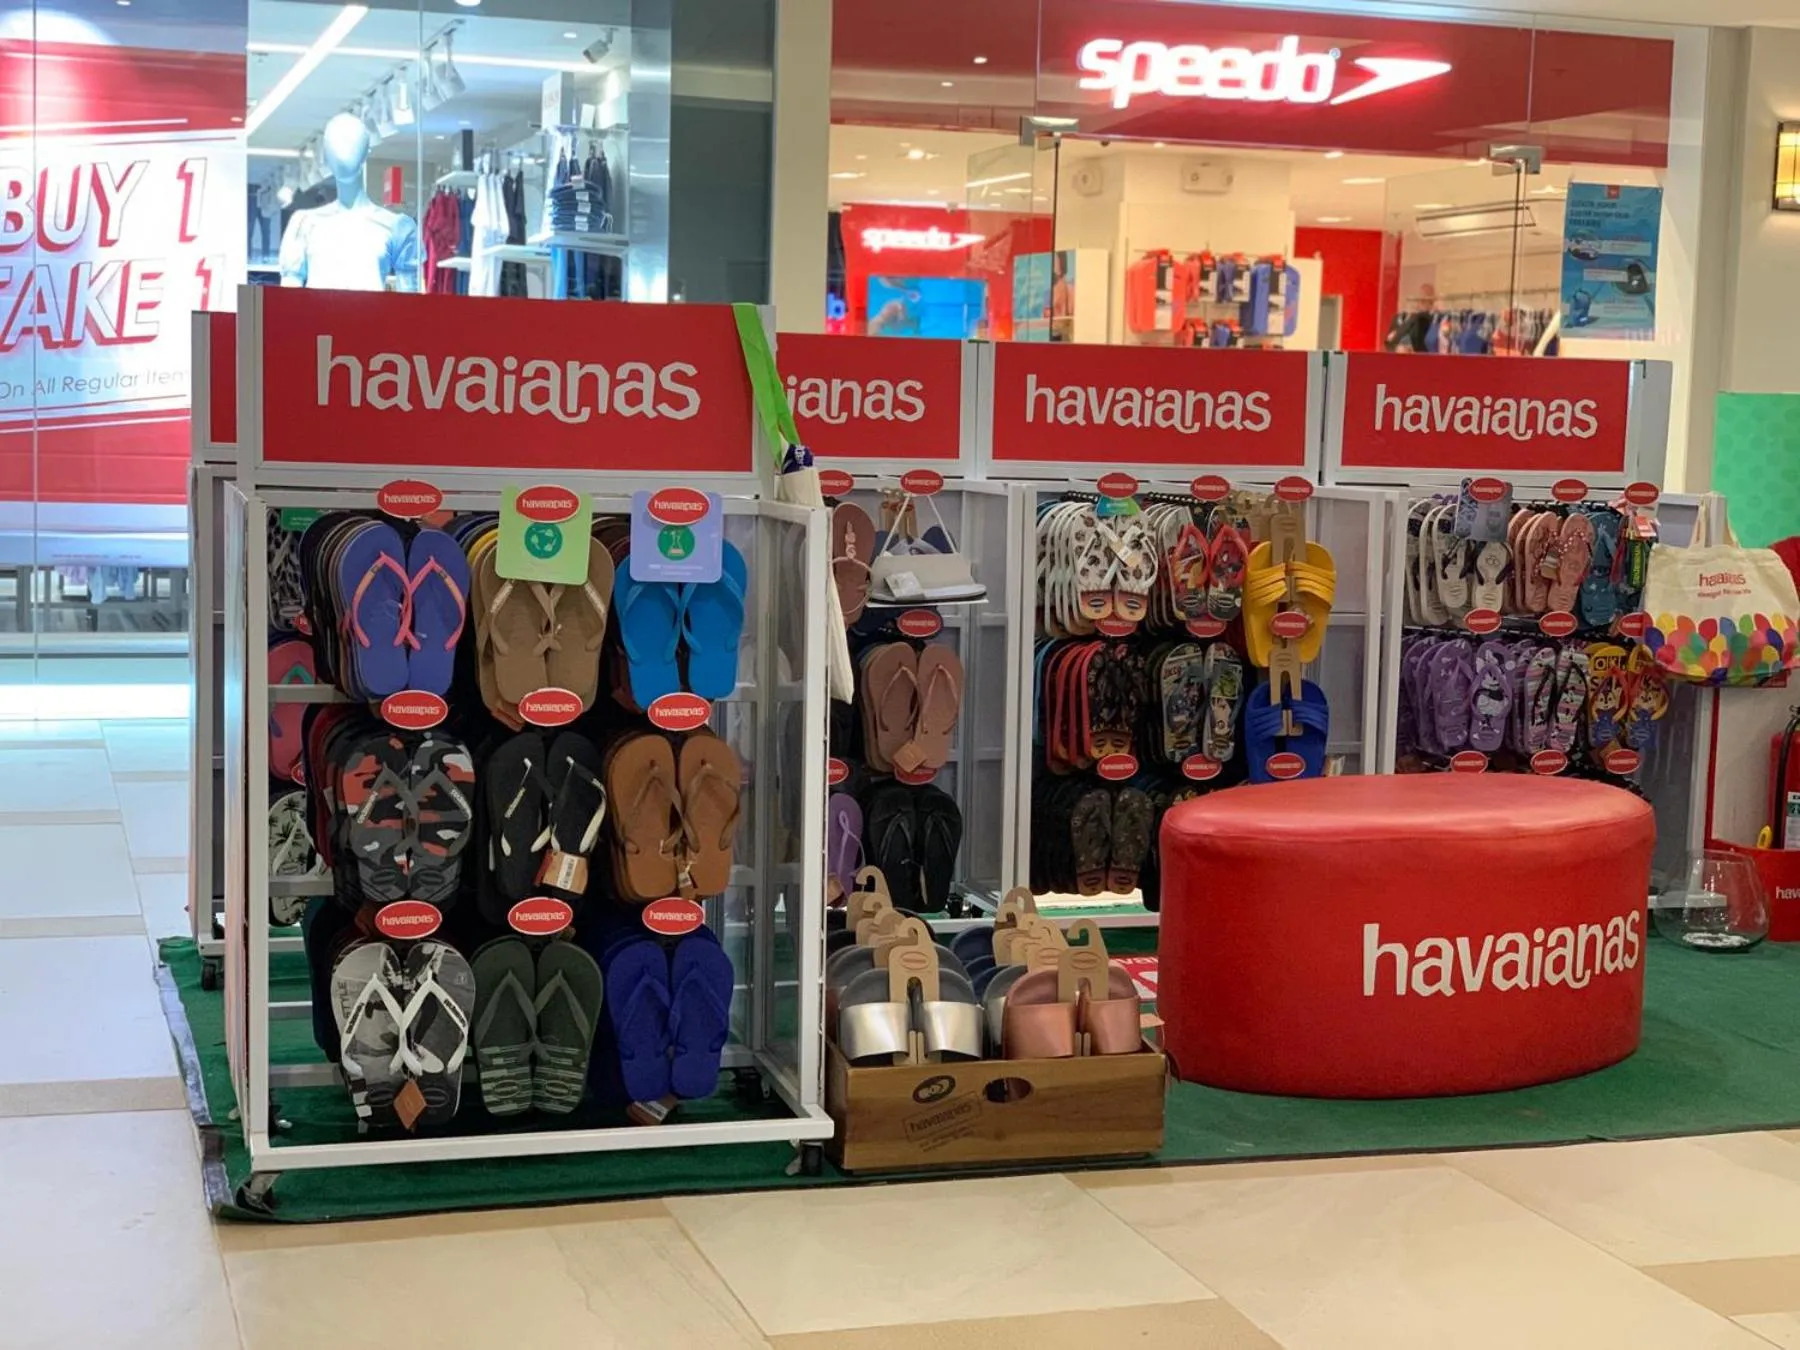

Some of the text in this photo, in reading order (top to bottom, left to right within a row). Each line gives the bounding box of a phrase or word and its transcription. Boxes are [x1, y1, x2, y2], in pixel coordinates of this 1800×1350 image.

[1078, 34, 1336, 109] speedo
[0, 157, 208, 254] BUY 1
[0, 255, 167, 353] AKE
[33, 376, 55, 396] All
[62, 373, 138, 394] Regular
[315, 334, 701, 424] havaianas
[787, 375, 926, 424] ianas
[1025, 374, 1272, 434] havaianas
[1374, 384, 1598, 441] havaianas
[1363, 910, 1640, 997] havaianas
